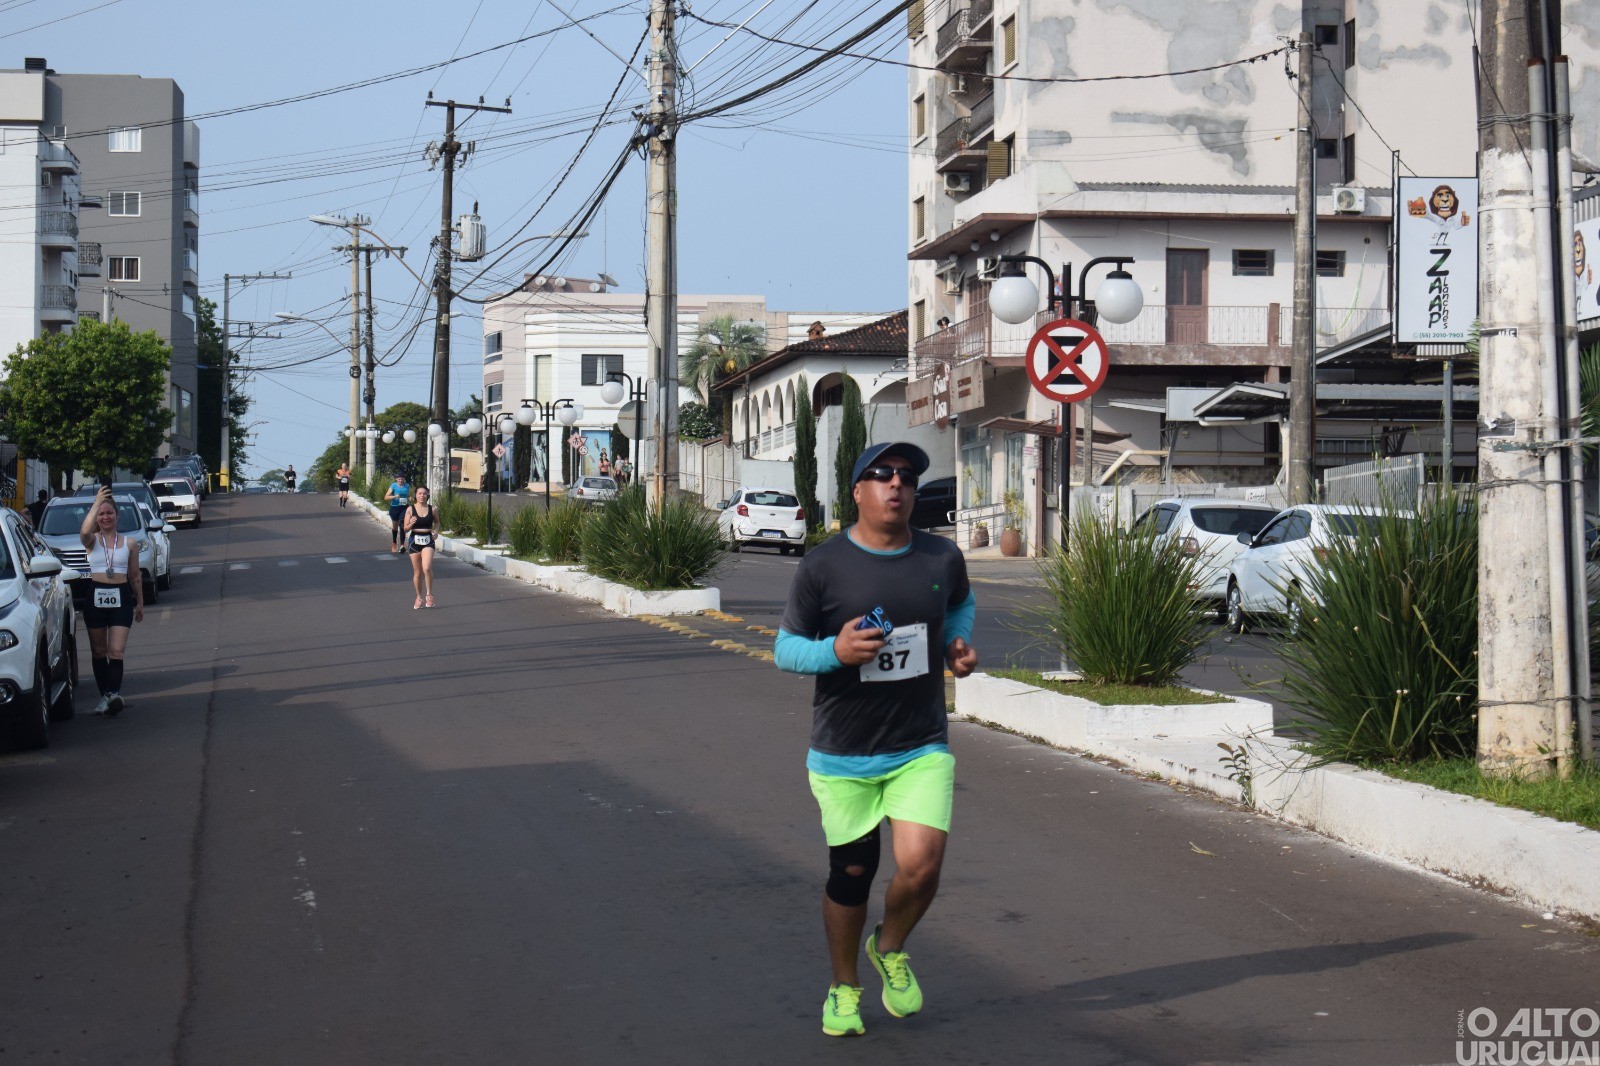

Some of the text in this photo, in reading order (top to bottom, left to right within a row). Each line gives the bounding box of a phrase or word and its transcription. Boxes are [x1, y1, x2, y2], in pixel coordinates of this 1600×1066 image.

[1426, 249, 1452, 328] ZAAP
[98, 597, 117, 605] 140
[878, 650, 909, 671] 87
